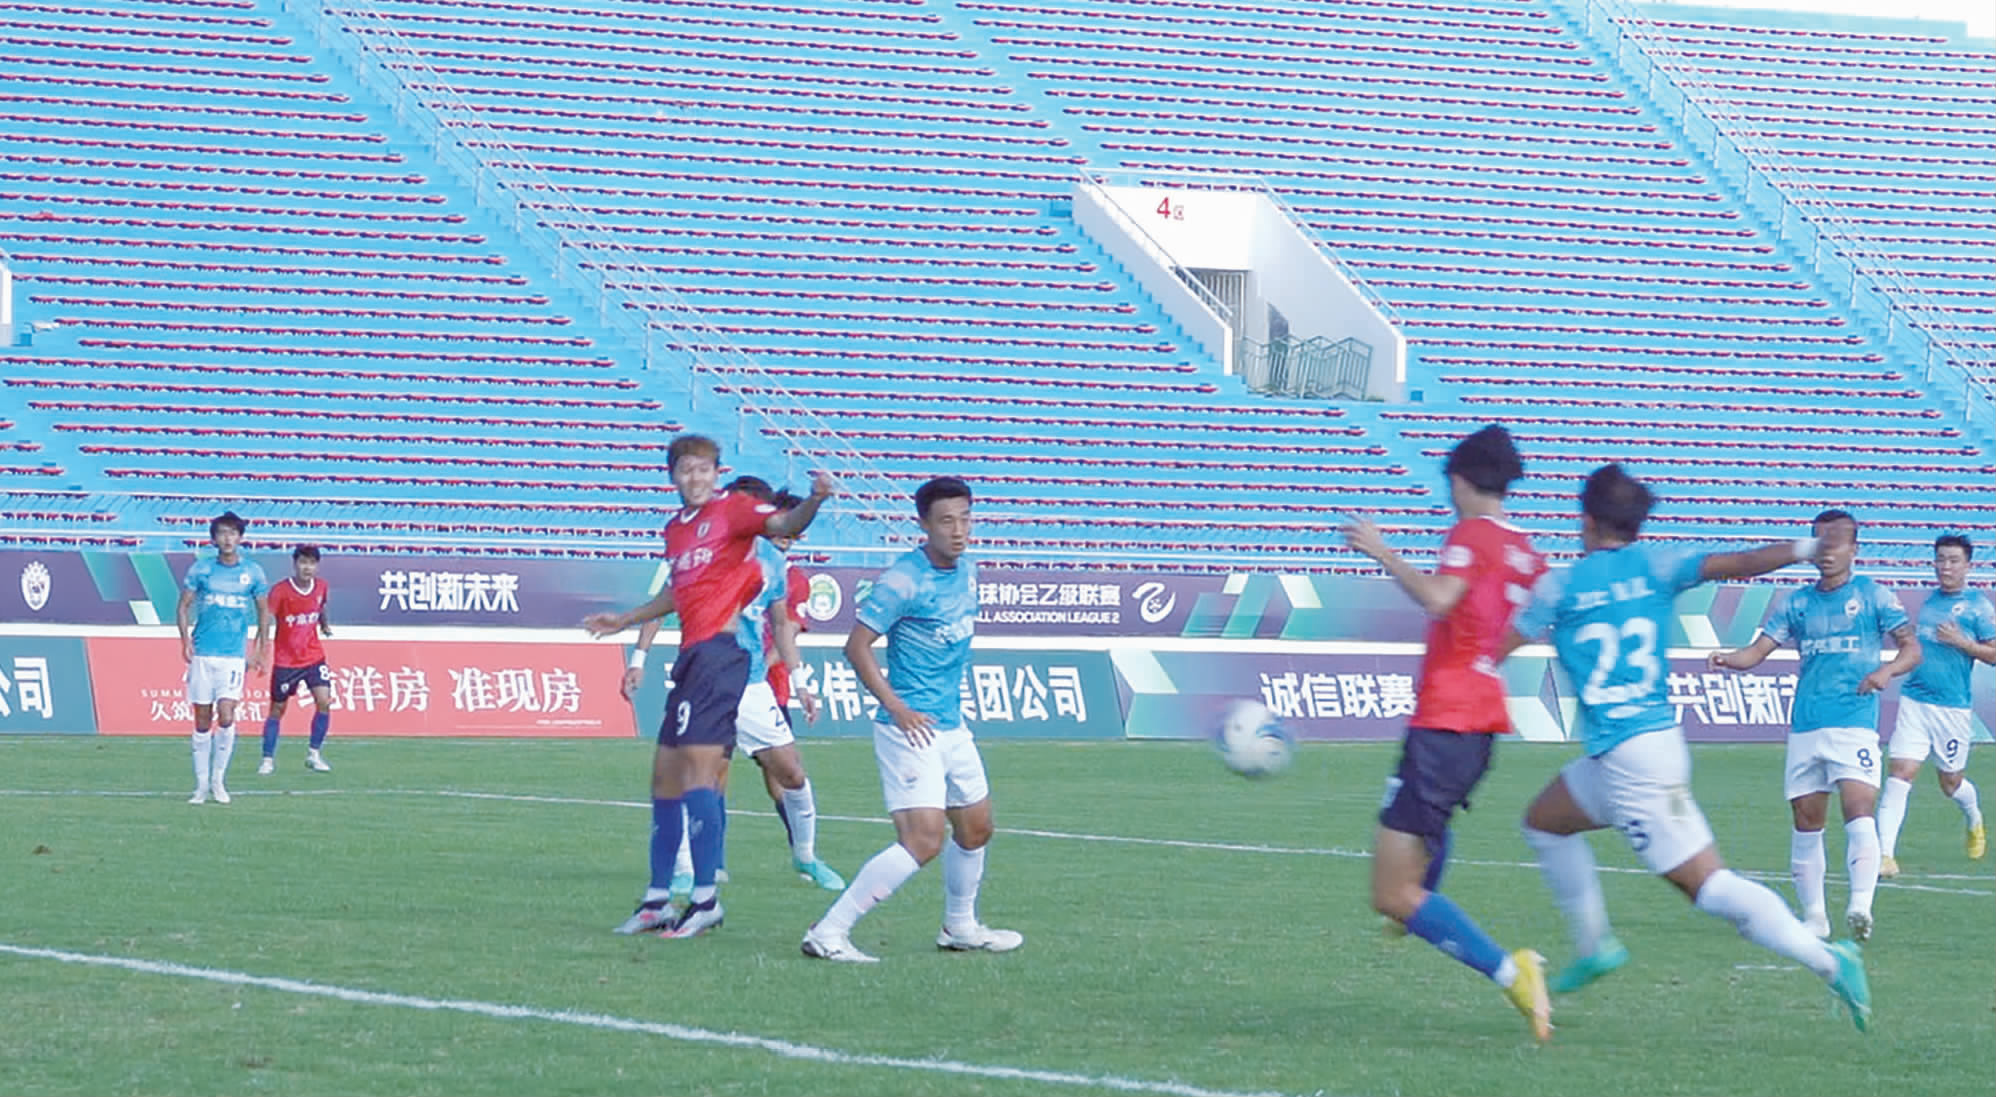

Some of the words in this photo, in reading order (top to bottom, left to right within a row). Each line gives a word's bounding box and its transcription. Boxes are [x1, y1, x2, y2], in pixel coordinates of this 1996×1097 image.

[379, 571, 520, 612] 共创新未来
[993, 611, 1067, 624] ASSOCIATION
[1068, 612, 1110, 624] LEAGUE
[1111, 612, 1121, 624] 2
[1575, 617, 1661, 705] 23
[448, 667, 582, 713] 准现房
[1260, 672, 1417, 718] 诚信联赛
[677, 701, 691, 736] 9
[1856, 748, 1873, 768] 8
[1946, 739, 1959, 760] 9
